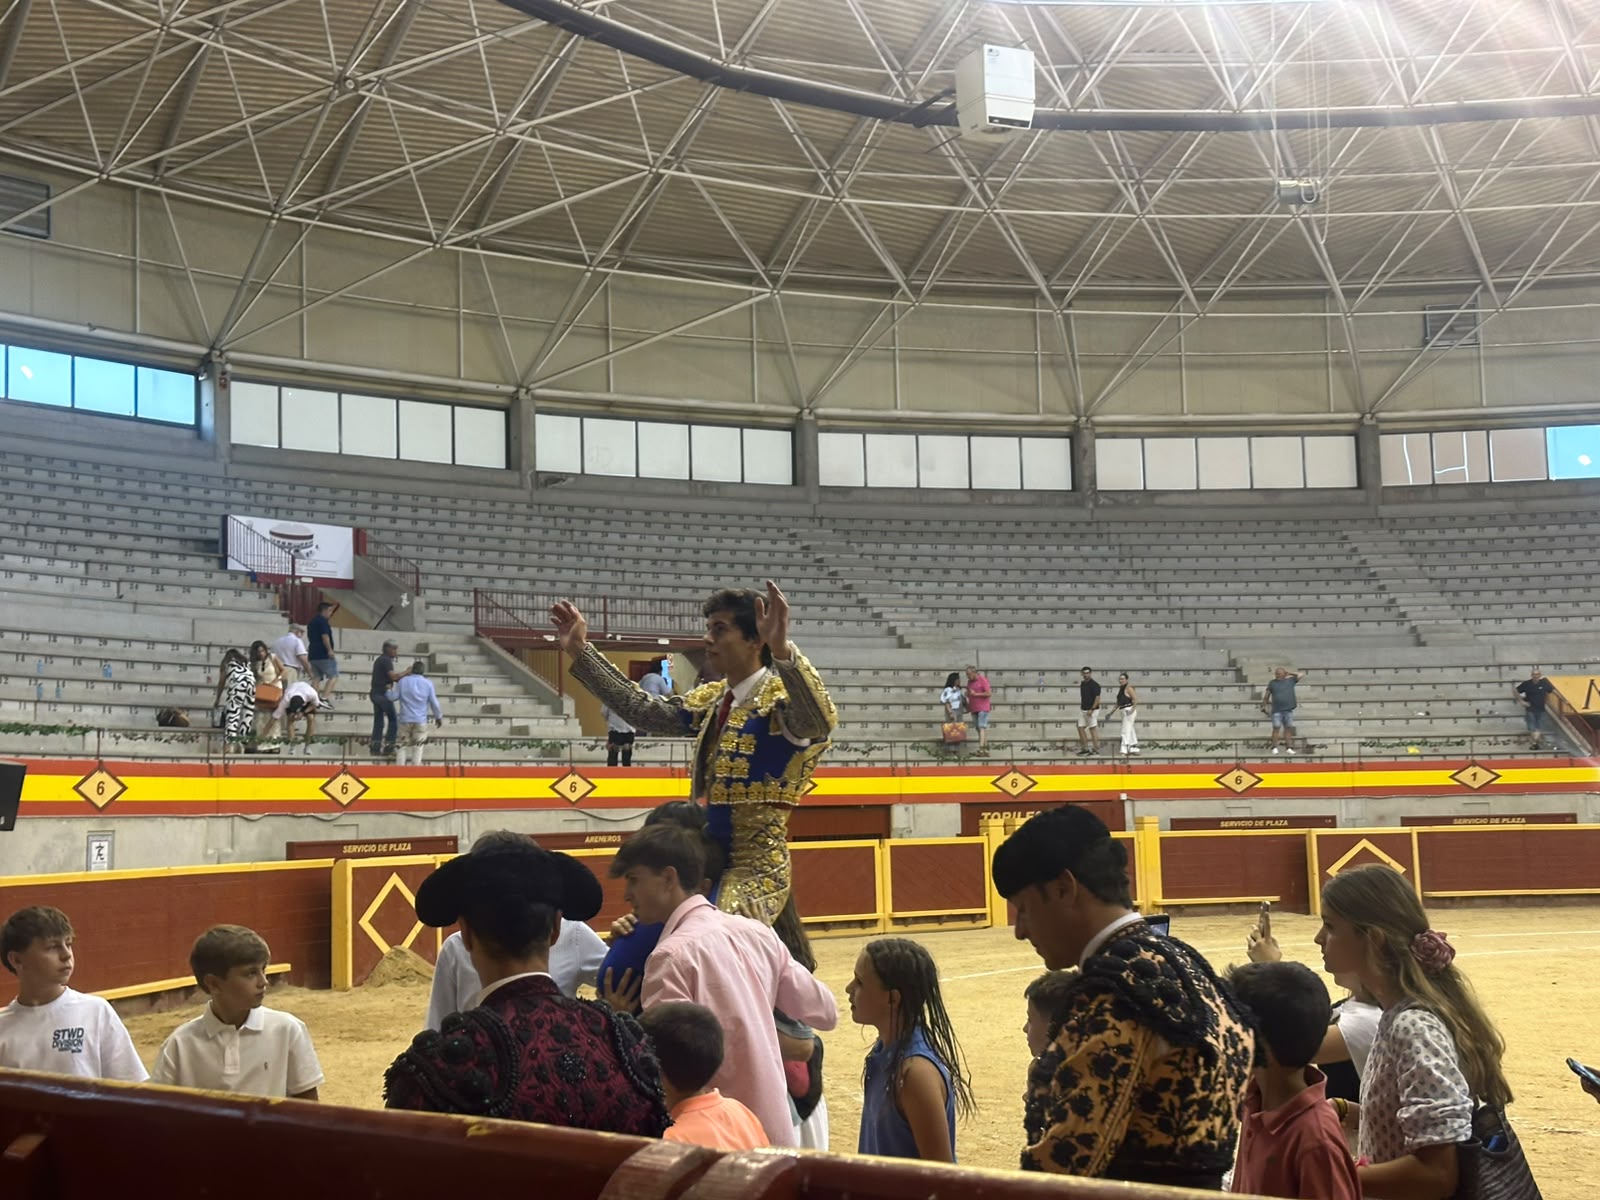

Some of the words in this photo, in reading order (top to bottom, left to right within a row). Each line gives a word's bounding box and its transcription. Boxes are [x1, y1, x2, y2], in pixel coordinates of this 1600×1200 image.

[1234, 776, 1242, 784] 6
[1470, 772, 1478, 782] 1
[96, 780, 105, 796] 6
[569, 782, 577, 793] 6
[1010, 778, 1018, 788] 6
[341, 782, 349, 795] 6
[585, 835, 622, 843] ARENEROS
[342, 844, 376, 854] SERVICIO
[378, 844, 388, 852] DE
[388, 842, 412, 852] PLAZA
[52, 1028, 84, 1040] STWD
[52, 1039, 84, 1048] DIVISION
